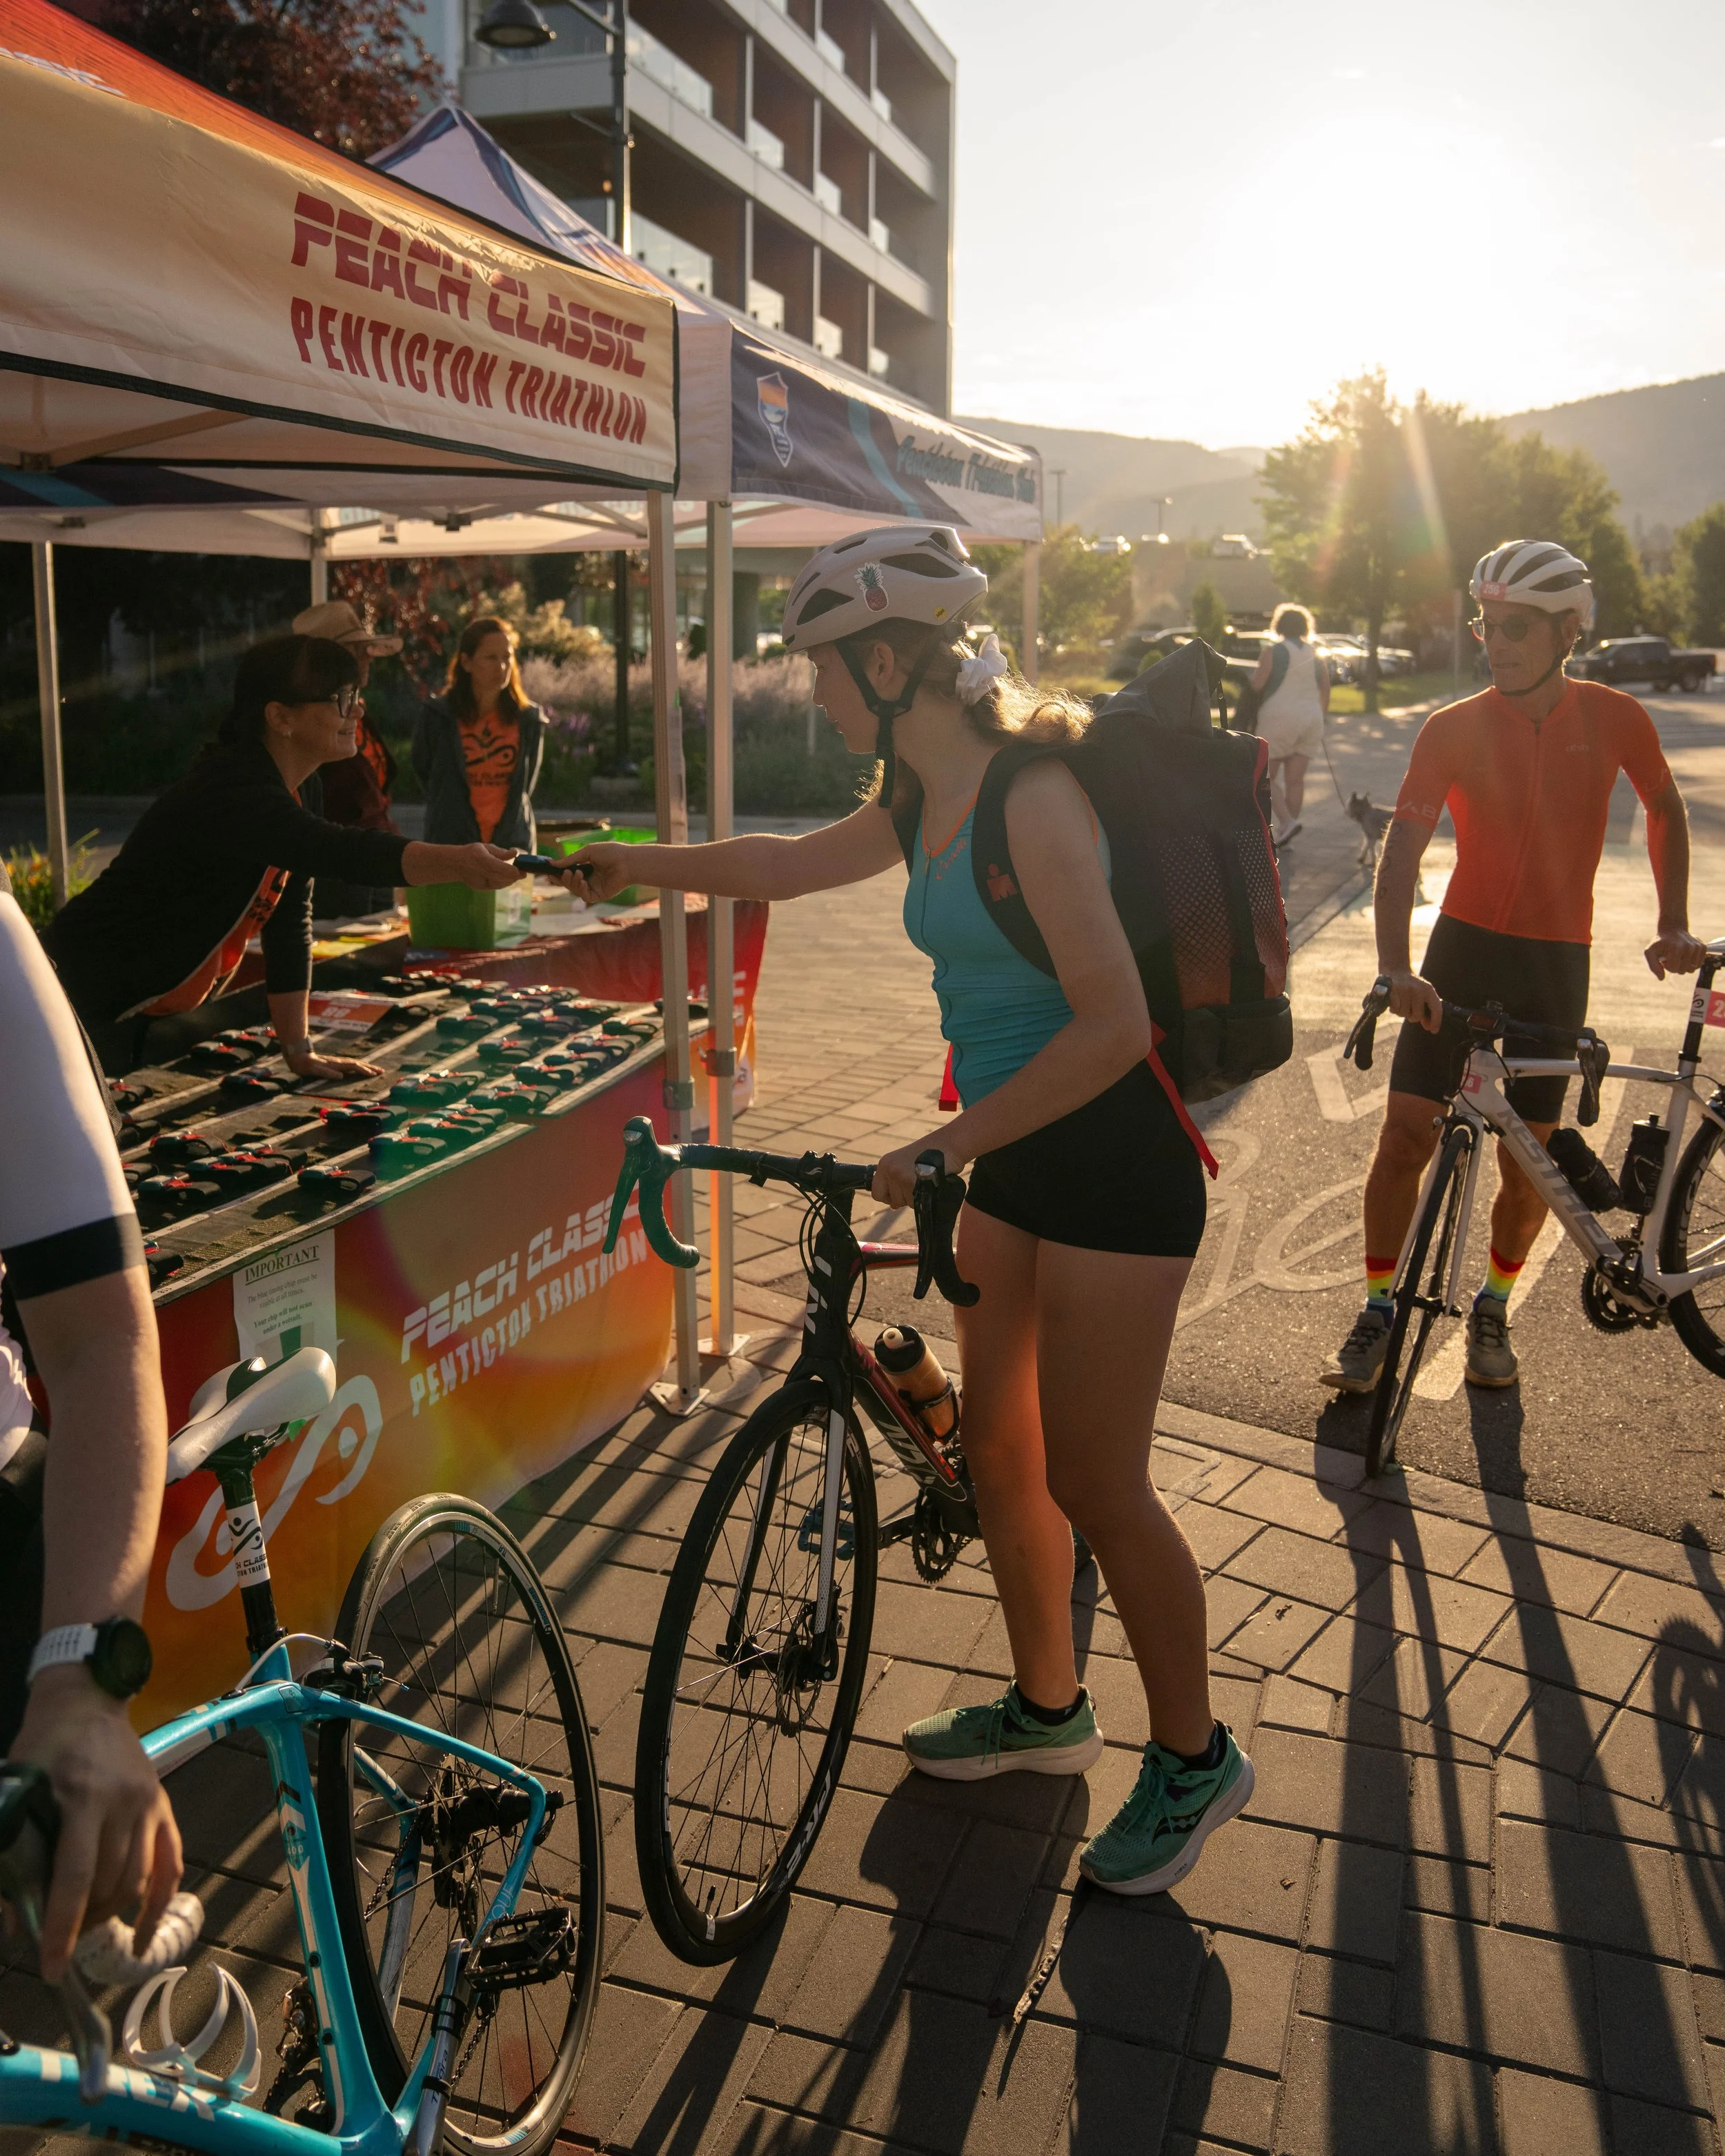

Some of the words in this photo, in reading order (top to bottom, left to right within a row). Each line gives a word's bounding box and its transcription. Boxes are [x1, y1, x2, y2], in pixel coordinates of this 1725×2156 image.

[291, 191, 473, 322] PEACH
[487, 268, 646, 378] CLASSIC
[290, 297, 498, 408] PENTICTON
[504, 359, 647, 445] TRIATHLON
[245, 1245, 319, 1283] IMPORTANT
[401, 1251, 519, 1364] PEACH
[409, 1297, 531, 1417] PENTICTON
